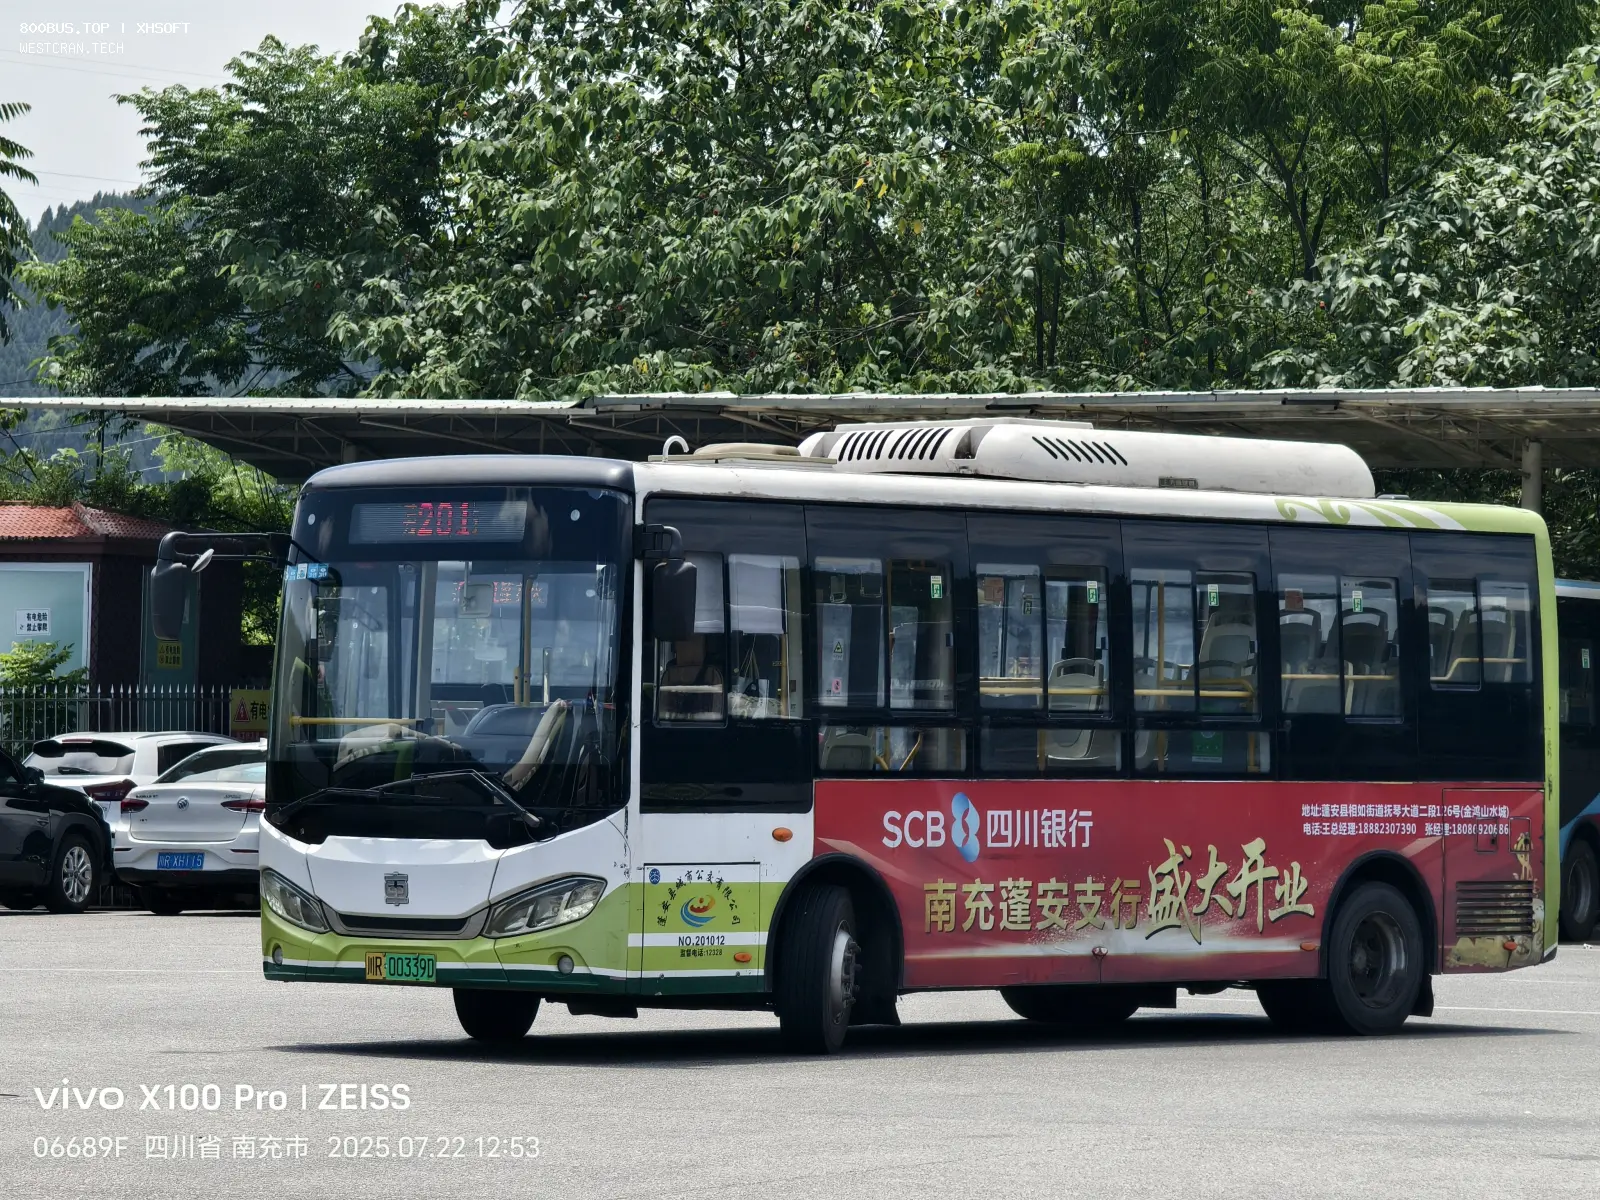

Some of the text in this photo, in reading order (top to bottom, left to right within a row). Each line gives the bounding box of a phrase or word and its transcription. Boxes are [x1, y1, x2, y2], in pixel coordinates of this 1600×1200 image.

[417, 502, 470, 536] 201
[250, 701, 270, 720] 有电
[882, 808, 1093, 849] SCB 四川银行
[923, 836, 1316, 944] 南充蓬安支行 盛大开业
[678, 935, 725, 947] NO.201012
